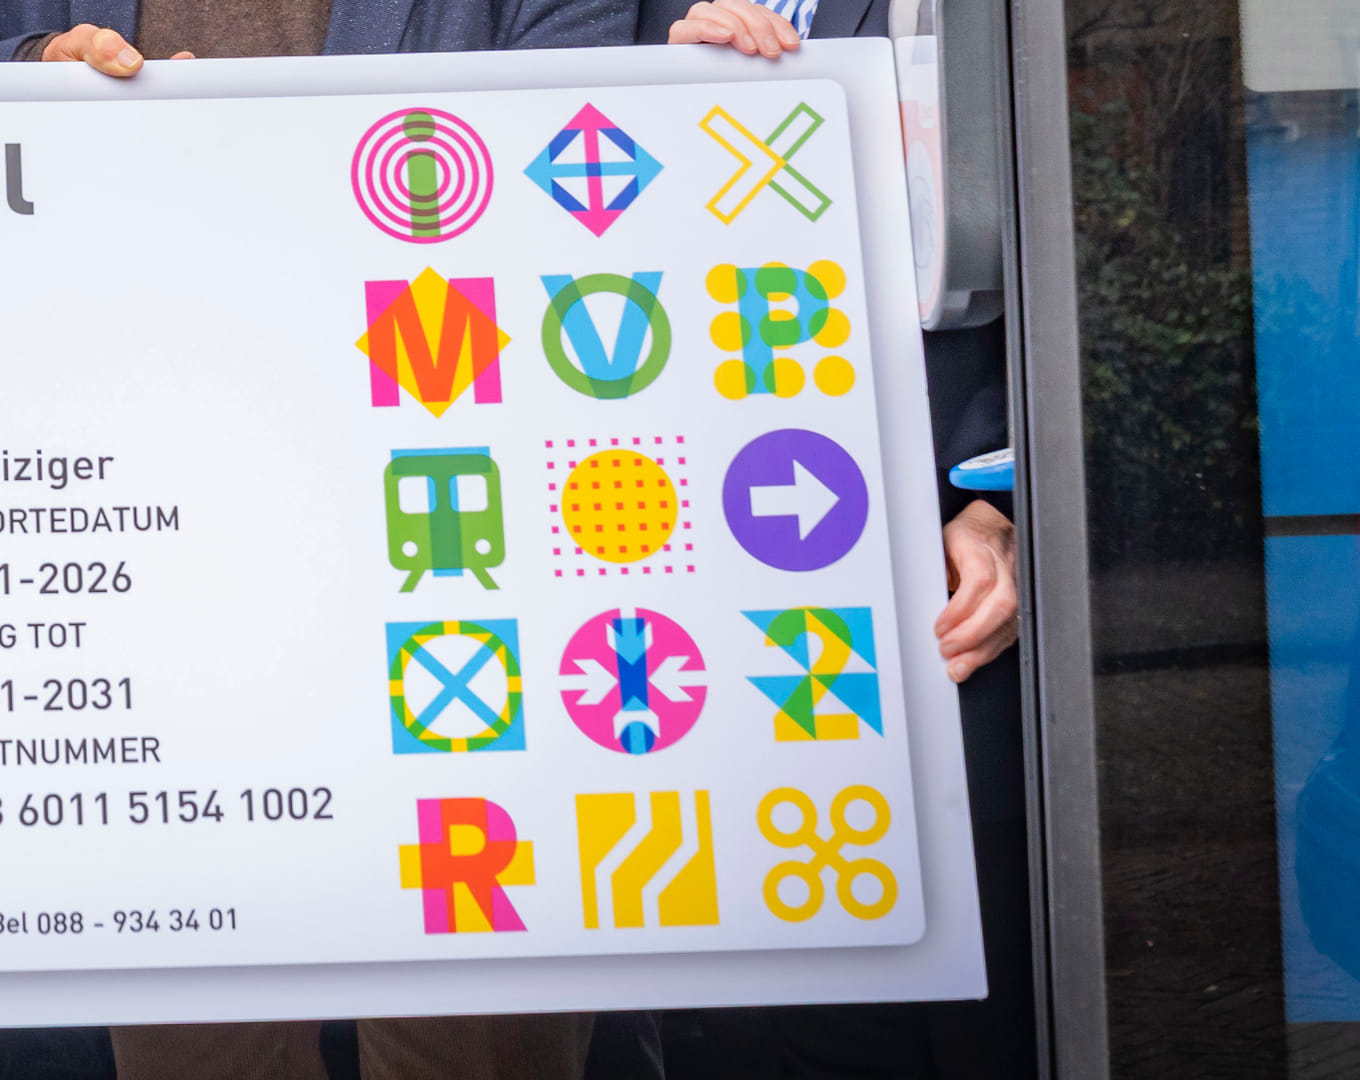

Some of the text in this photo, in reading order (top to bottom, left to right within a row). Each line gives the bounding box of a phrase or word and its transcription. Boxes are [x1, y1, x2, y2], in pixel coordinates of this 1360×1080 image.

[27, 622, 87, 649] TOT
[18, 792, 109, 827] 6011
[128, 790, 225, 824] 5154
[240, 786, 335, 822] 1002
[37, 911, 84, 935] 088
[113, 910, 160, 933] 934
[169, 908, 200, 932] 34
[209, 907, 237, 931] 01
